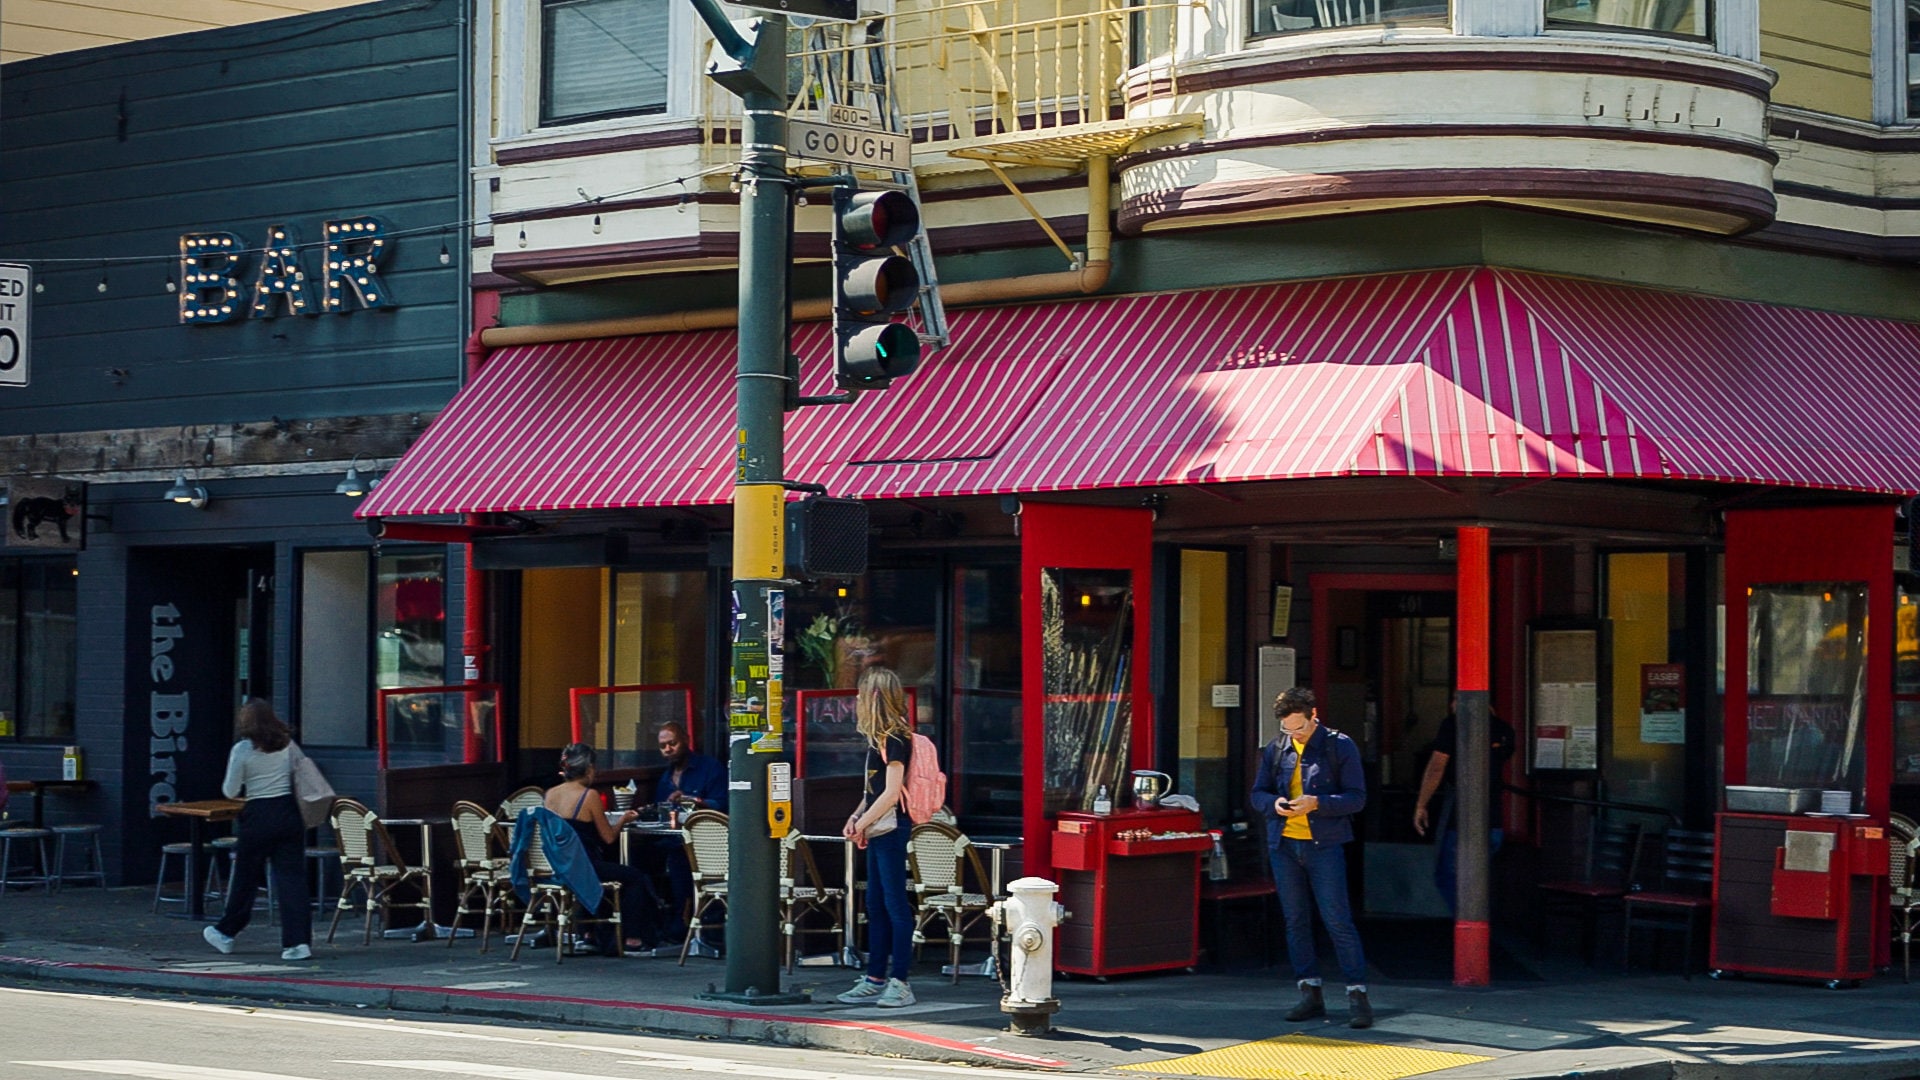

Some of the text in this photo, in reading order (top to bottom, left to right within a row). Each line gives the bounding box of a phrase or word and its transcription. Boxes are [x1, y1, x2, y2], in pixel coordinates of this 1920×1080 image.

[805, 130, 894, 161] GOUGH
[833, 109, 858, 123] 400
[179, 215, 394, 323] BAR
[149, 602, 190, 819] the Bird
